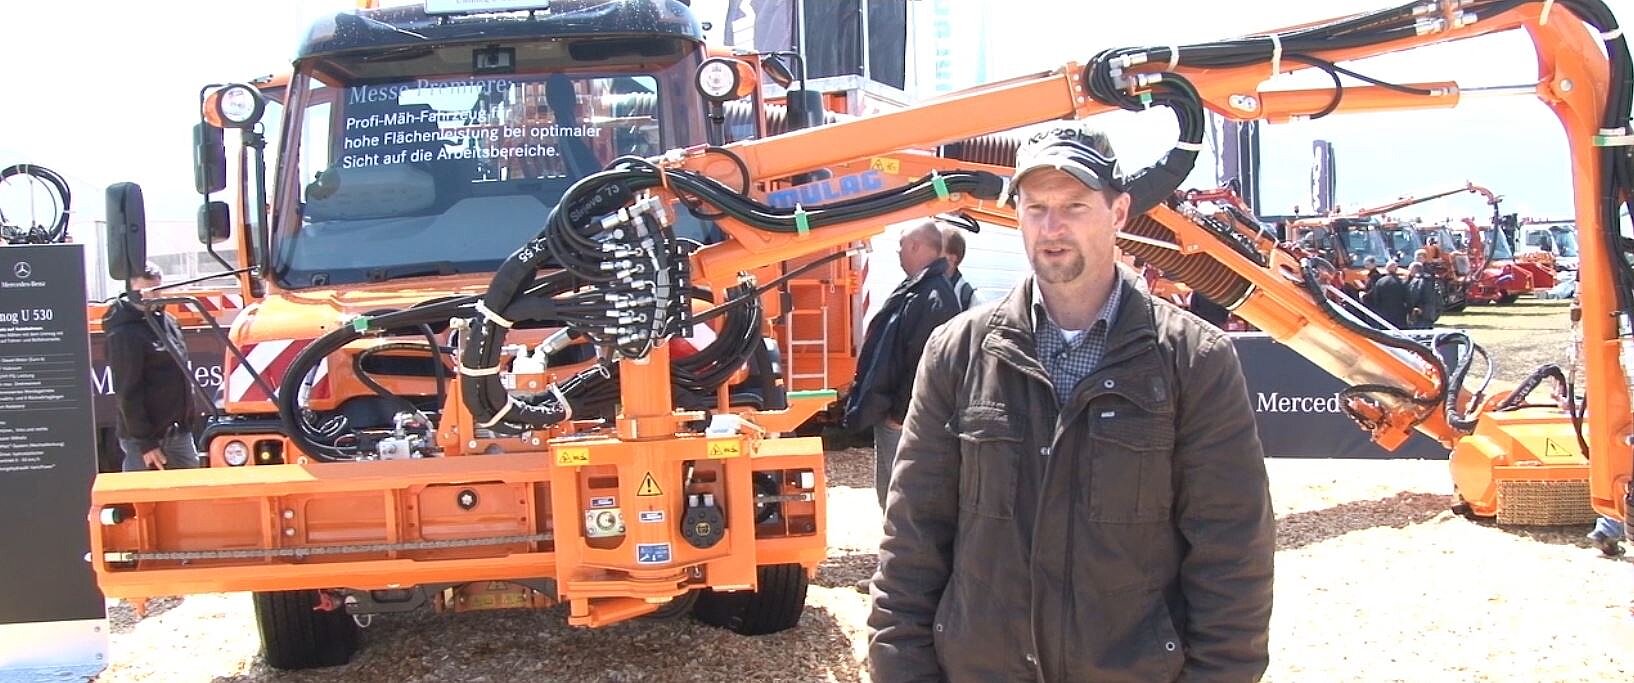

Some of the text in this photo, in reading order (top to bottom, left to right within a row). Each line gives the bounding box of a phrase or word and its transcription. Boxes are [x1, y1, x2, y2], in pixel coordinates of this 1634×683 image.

[349, 84, 408, 104] Messe
[343, 124, 602, 149] hohe Flächenleistung bei optimaler
[342, 145, 560, 169] Sicht auf die Arbeitsbereiche.
[767, 169, 881, 209] MULAG
[21, 309, 30, 321] U
[33, 308, 53, 321] 530
[1256, 392, 1341, 413] Merced
